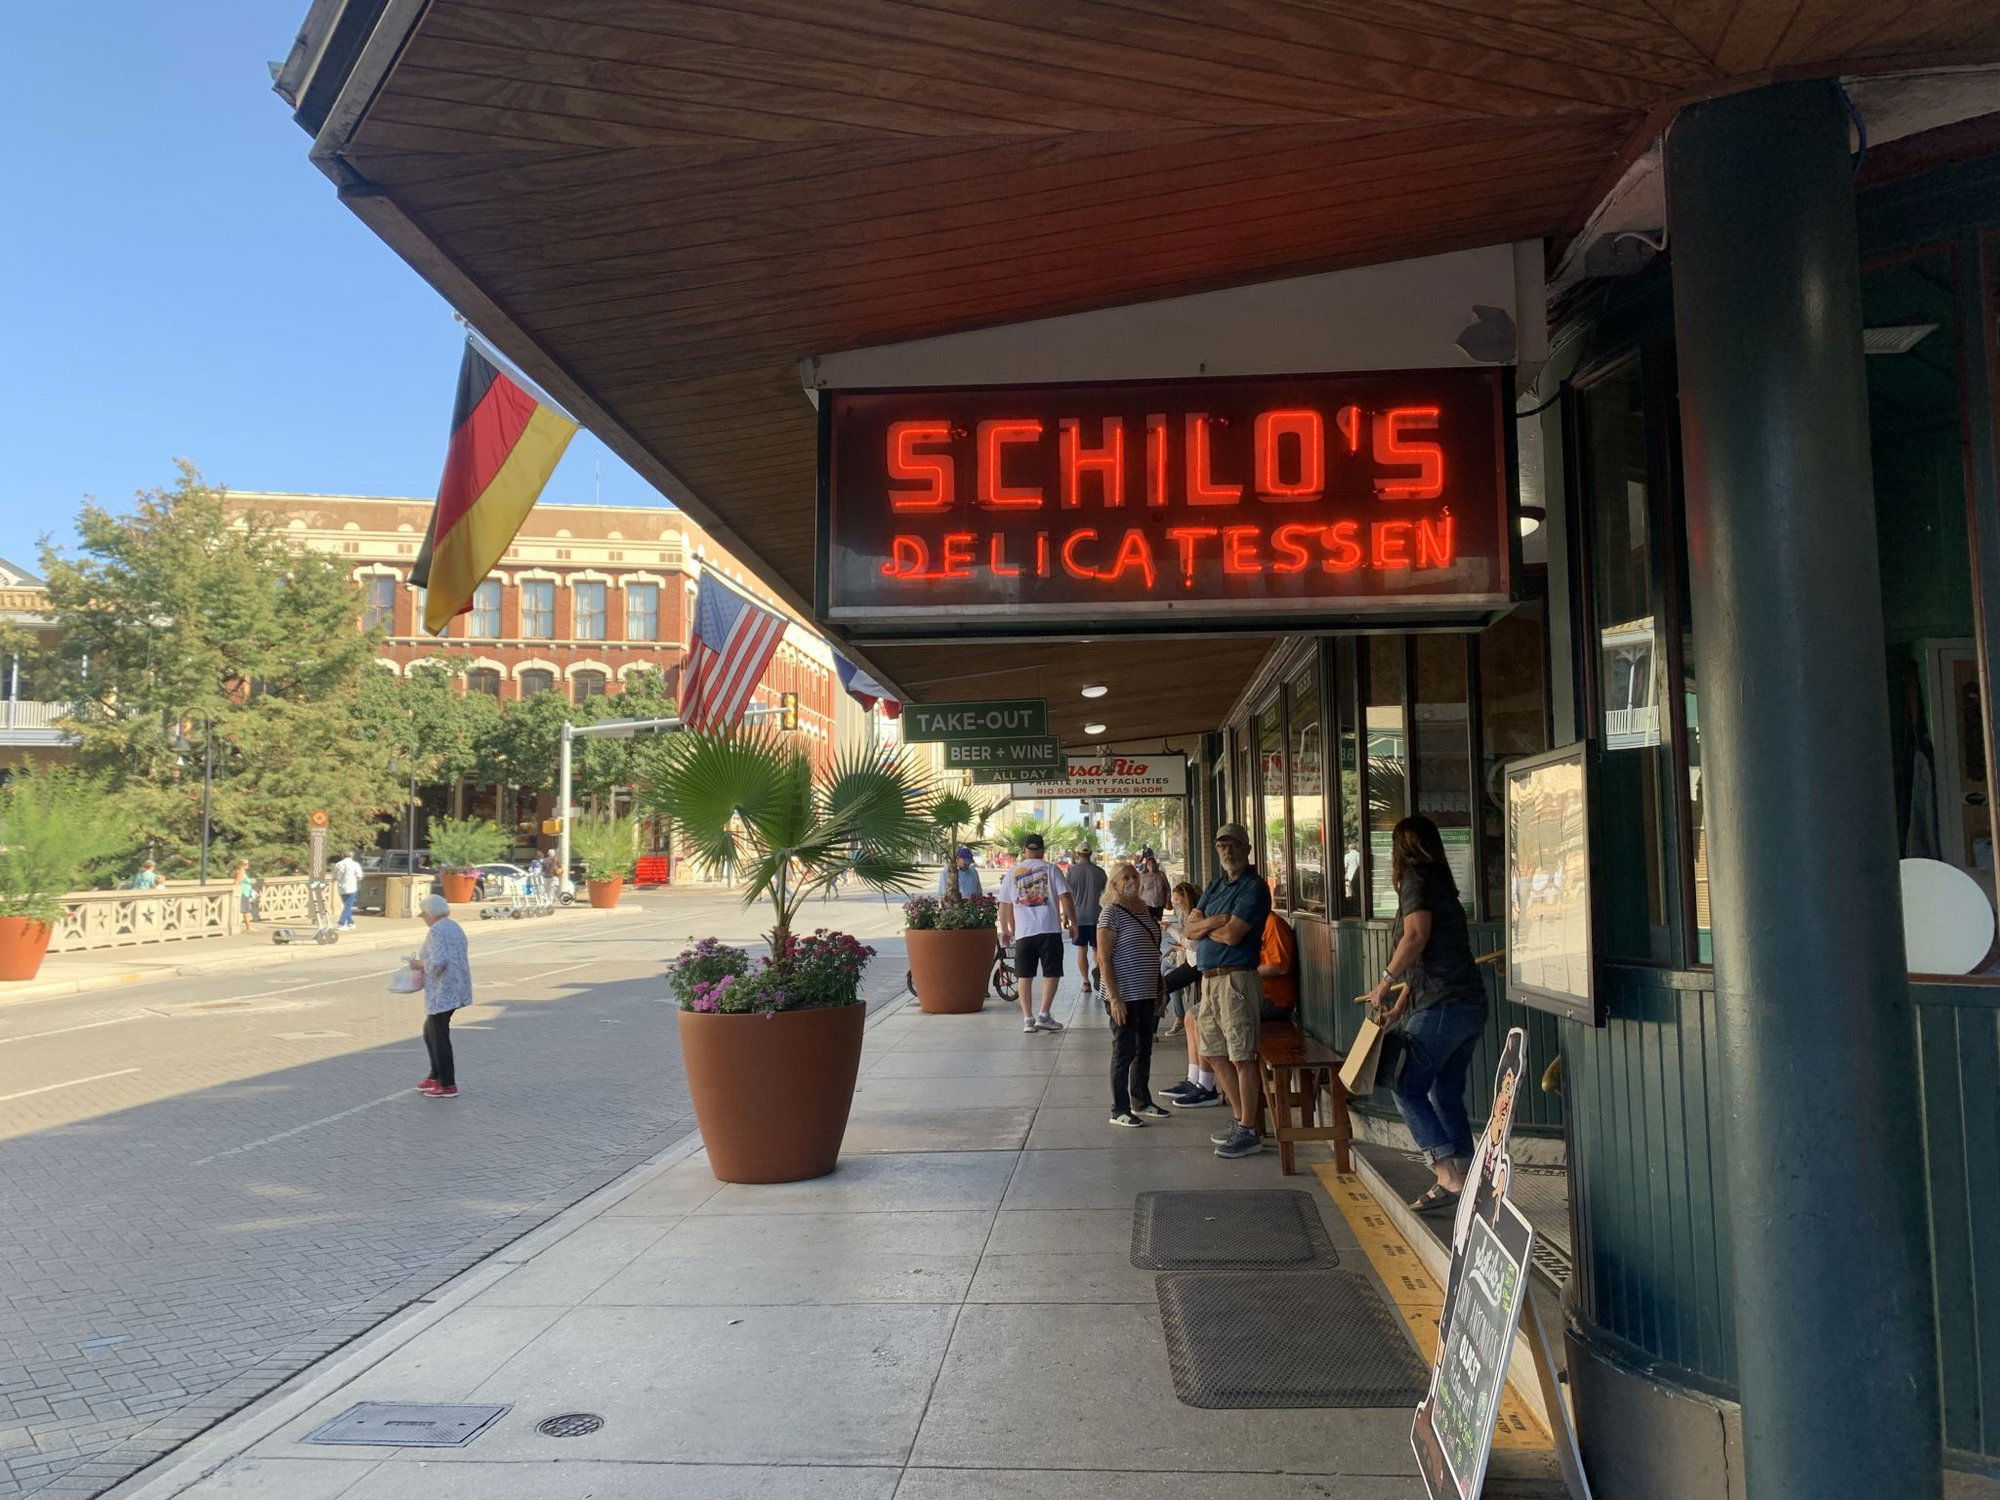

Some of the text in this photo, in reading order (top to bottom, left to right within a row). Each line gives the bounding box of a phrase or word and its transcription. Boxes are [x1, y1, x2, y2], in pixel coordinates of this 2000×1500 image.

[886, 405, 1444, 513] SCHILO'S
[881, 513, 1453, 588] DELICATESSEN
[917, 709, 1033, 732] TAKE-OUT
[951, 744, 1053, 760] BEER + WINE
[993, 769, 1047, 780] ALL DAY
[1067, 758, 1149, 777] asa Rio
[1058, 787, 1086, 795] ROOM
[1097, 786, 1130, 794] TEXAS
[1133, 786, 1163, 794] ROOM
[1112, 777, 1169, 785] FACILITIES
[1460, 1334, 1481, 1388] OLDEST
